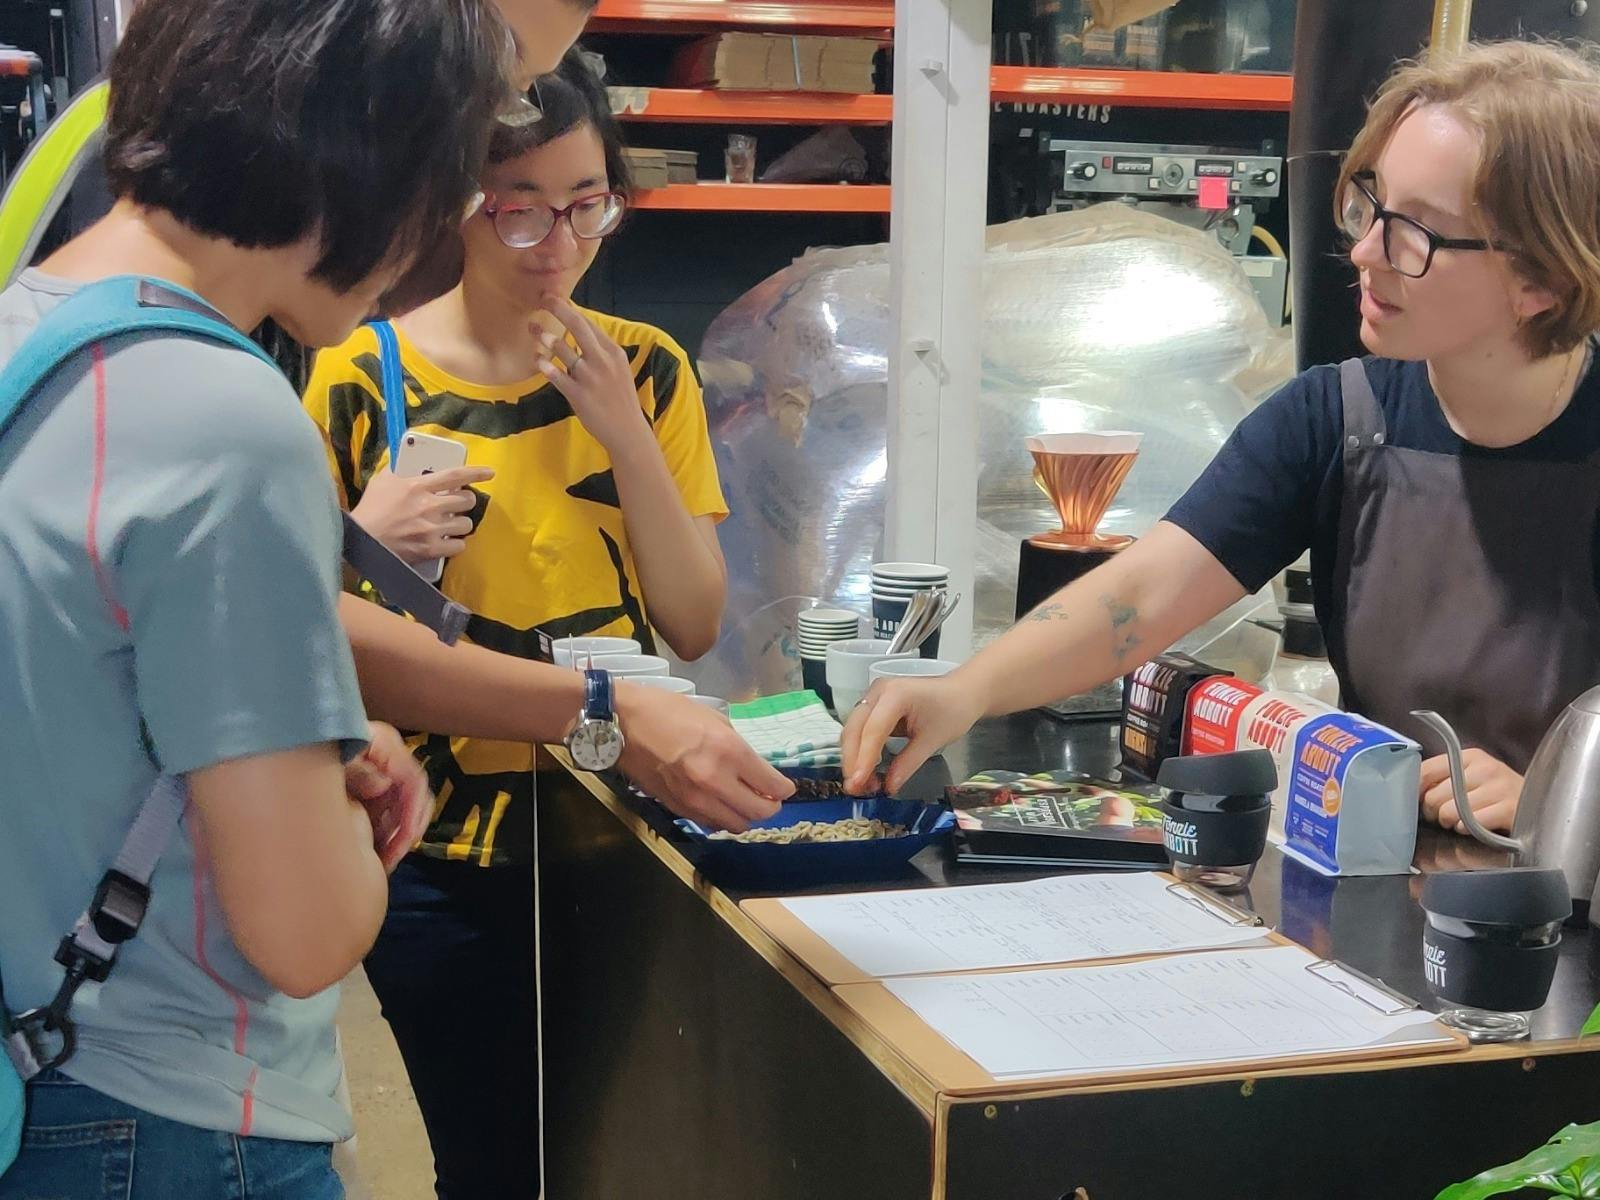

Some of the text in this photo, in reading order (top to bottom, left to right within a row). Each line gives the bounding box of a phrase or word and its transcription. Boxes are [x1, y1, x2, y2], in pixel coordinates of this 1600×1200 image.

[1129, 682, 1168, 716] ABBOTT
[1203, 682, 1253, 705] FONZIE
[1193, 697, 1235, 728] ABBOTT
[1256, 699, 1307, 728] FONZIE
[1247, 718, 1287, 754] ABBOTT
[1310, 724, 1364, 753] FONZIE
[1300, 741, 1342, 777] ABBOTT
